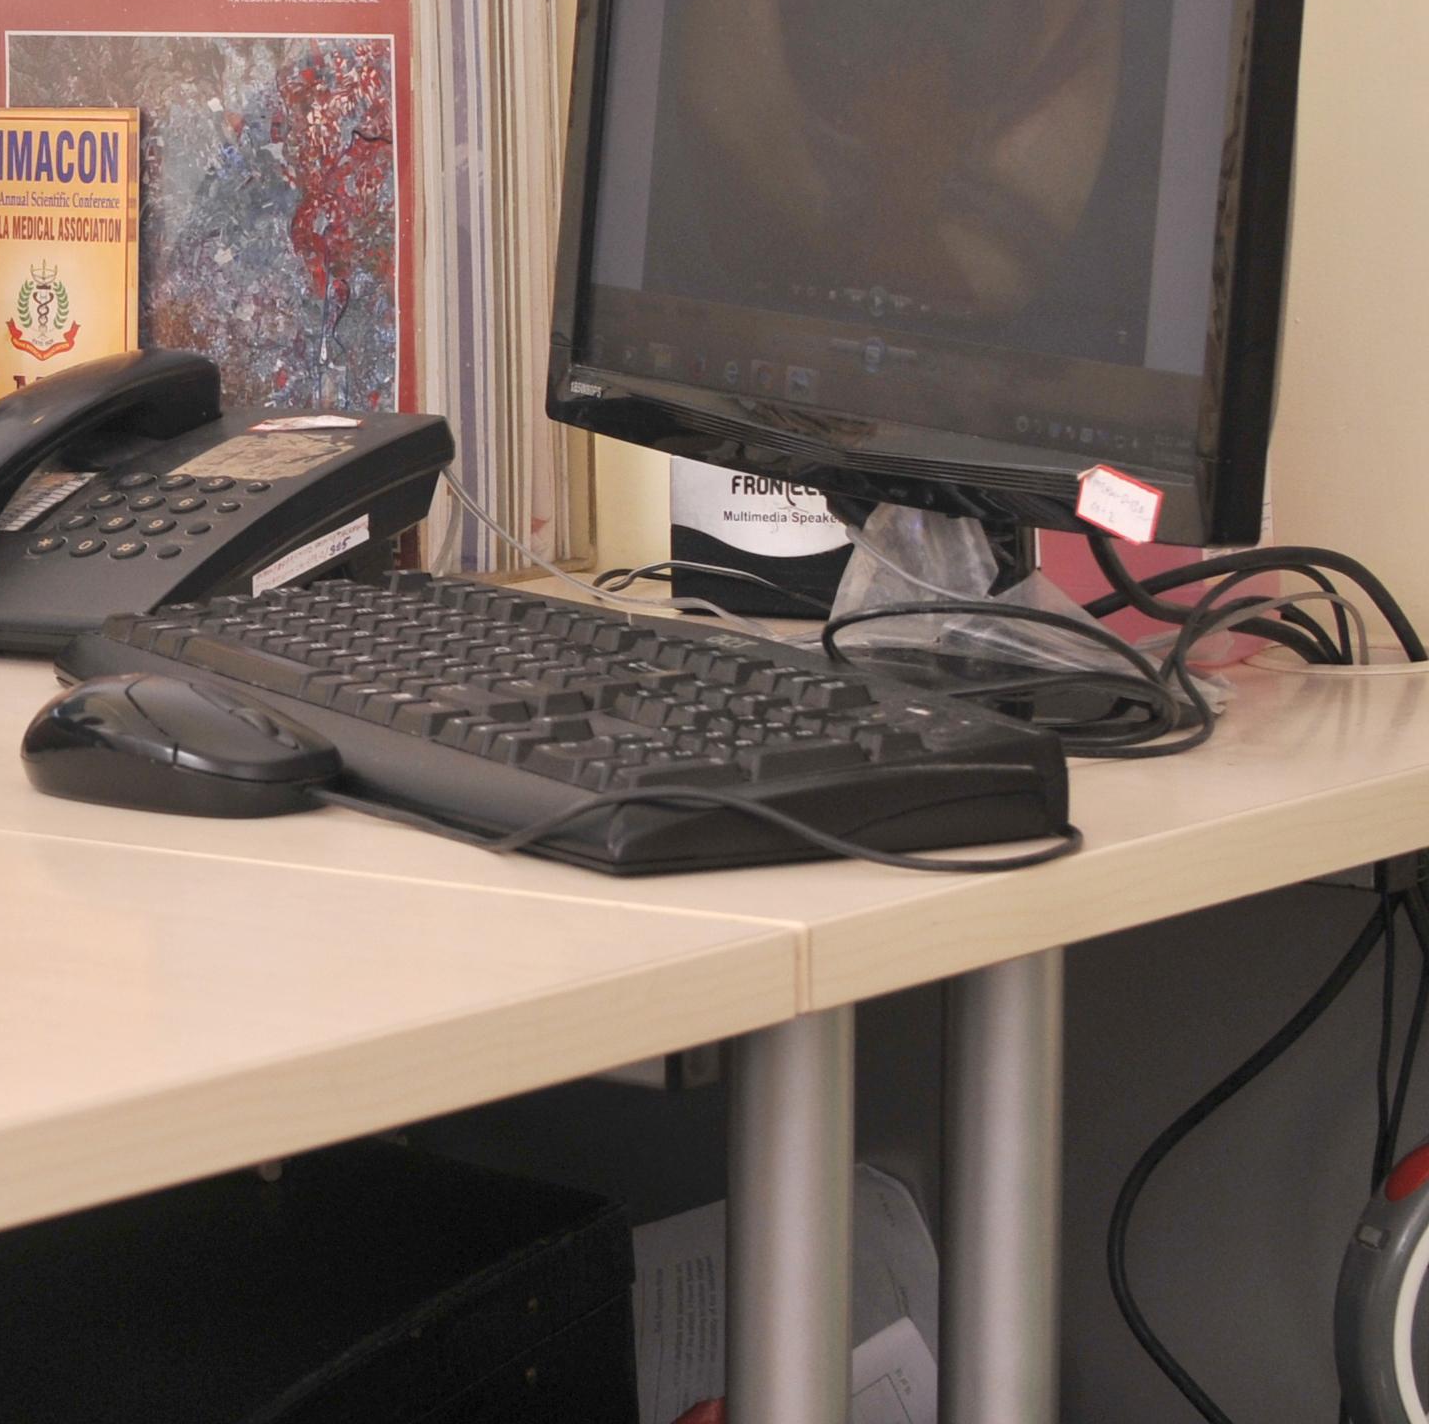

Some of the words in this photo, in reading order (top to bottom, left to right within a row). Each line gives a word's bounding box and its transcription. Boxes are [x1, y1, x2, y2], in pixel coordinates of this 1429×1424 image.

[0, 191, 29, 206] Annual
[31, 191, 70, 208] Scientific
[72, 193, 120, 209] Conference
[13, 216, 54, 241] MEDICAL
[58, 217, 121, 243] ASSOCIATION
[723, 510, 787, 523] Multimedia
